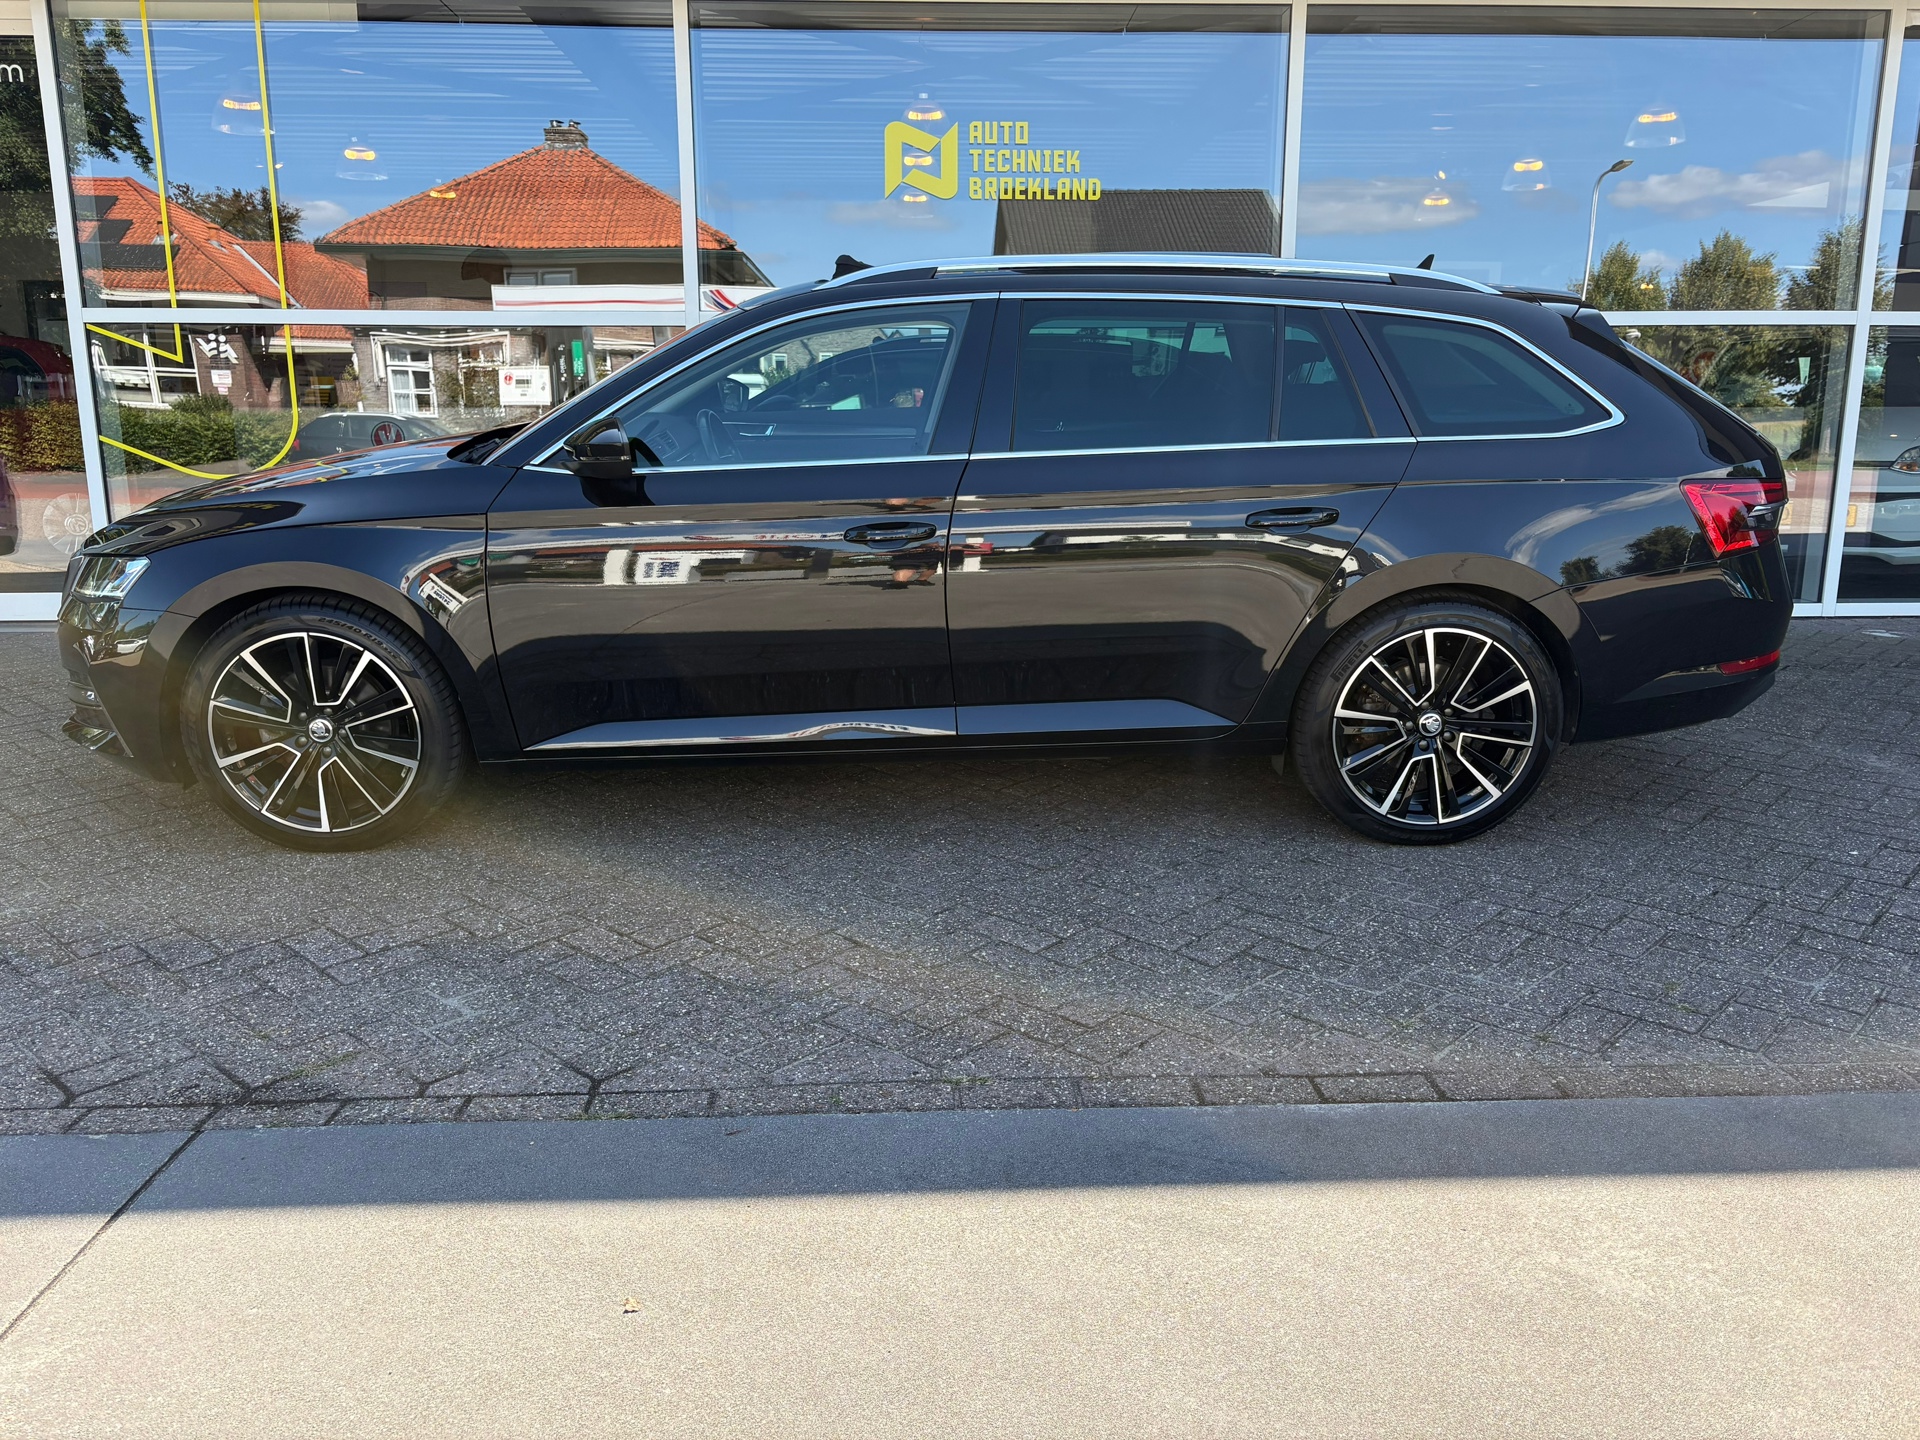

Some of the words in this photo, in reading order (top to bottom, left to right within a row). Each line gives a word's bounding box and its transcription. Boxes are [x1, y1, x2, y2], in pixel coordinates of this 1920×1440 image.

[969, 121, 1029, 144] AUTO
[969, 149, 1080, 173] TECHNIEK
[968, 177, 1101, 200] BROEKLAND
[1330, 640, 1368, 682] PIRELLI
